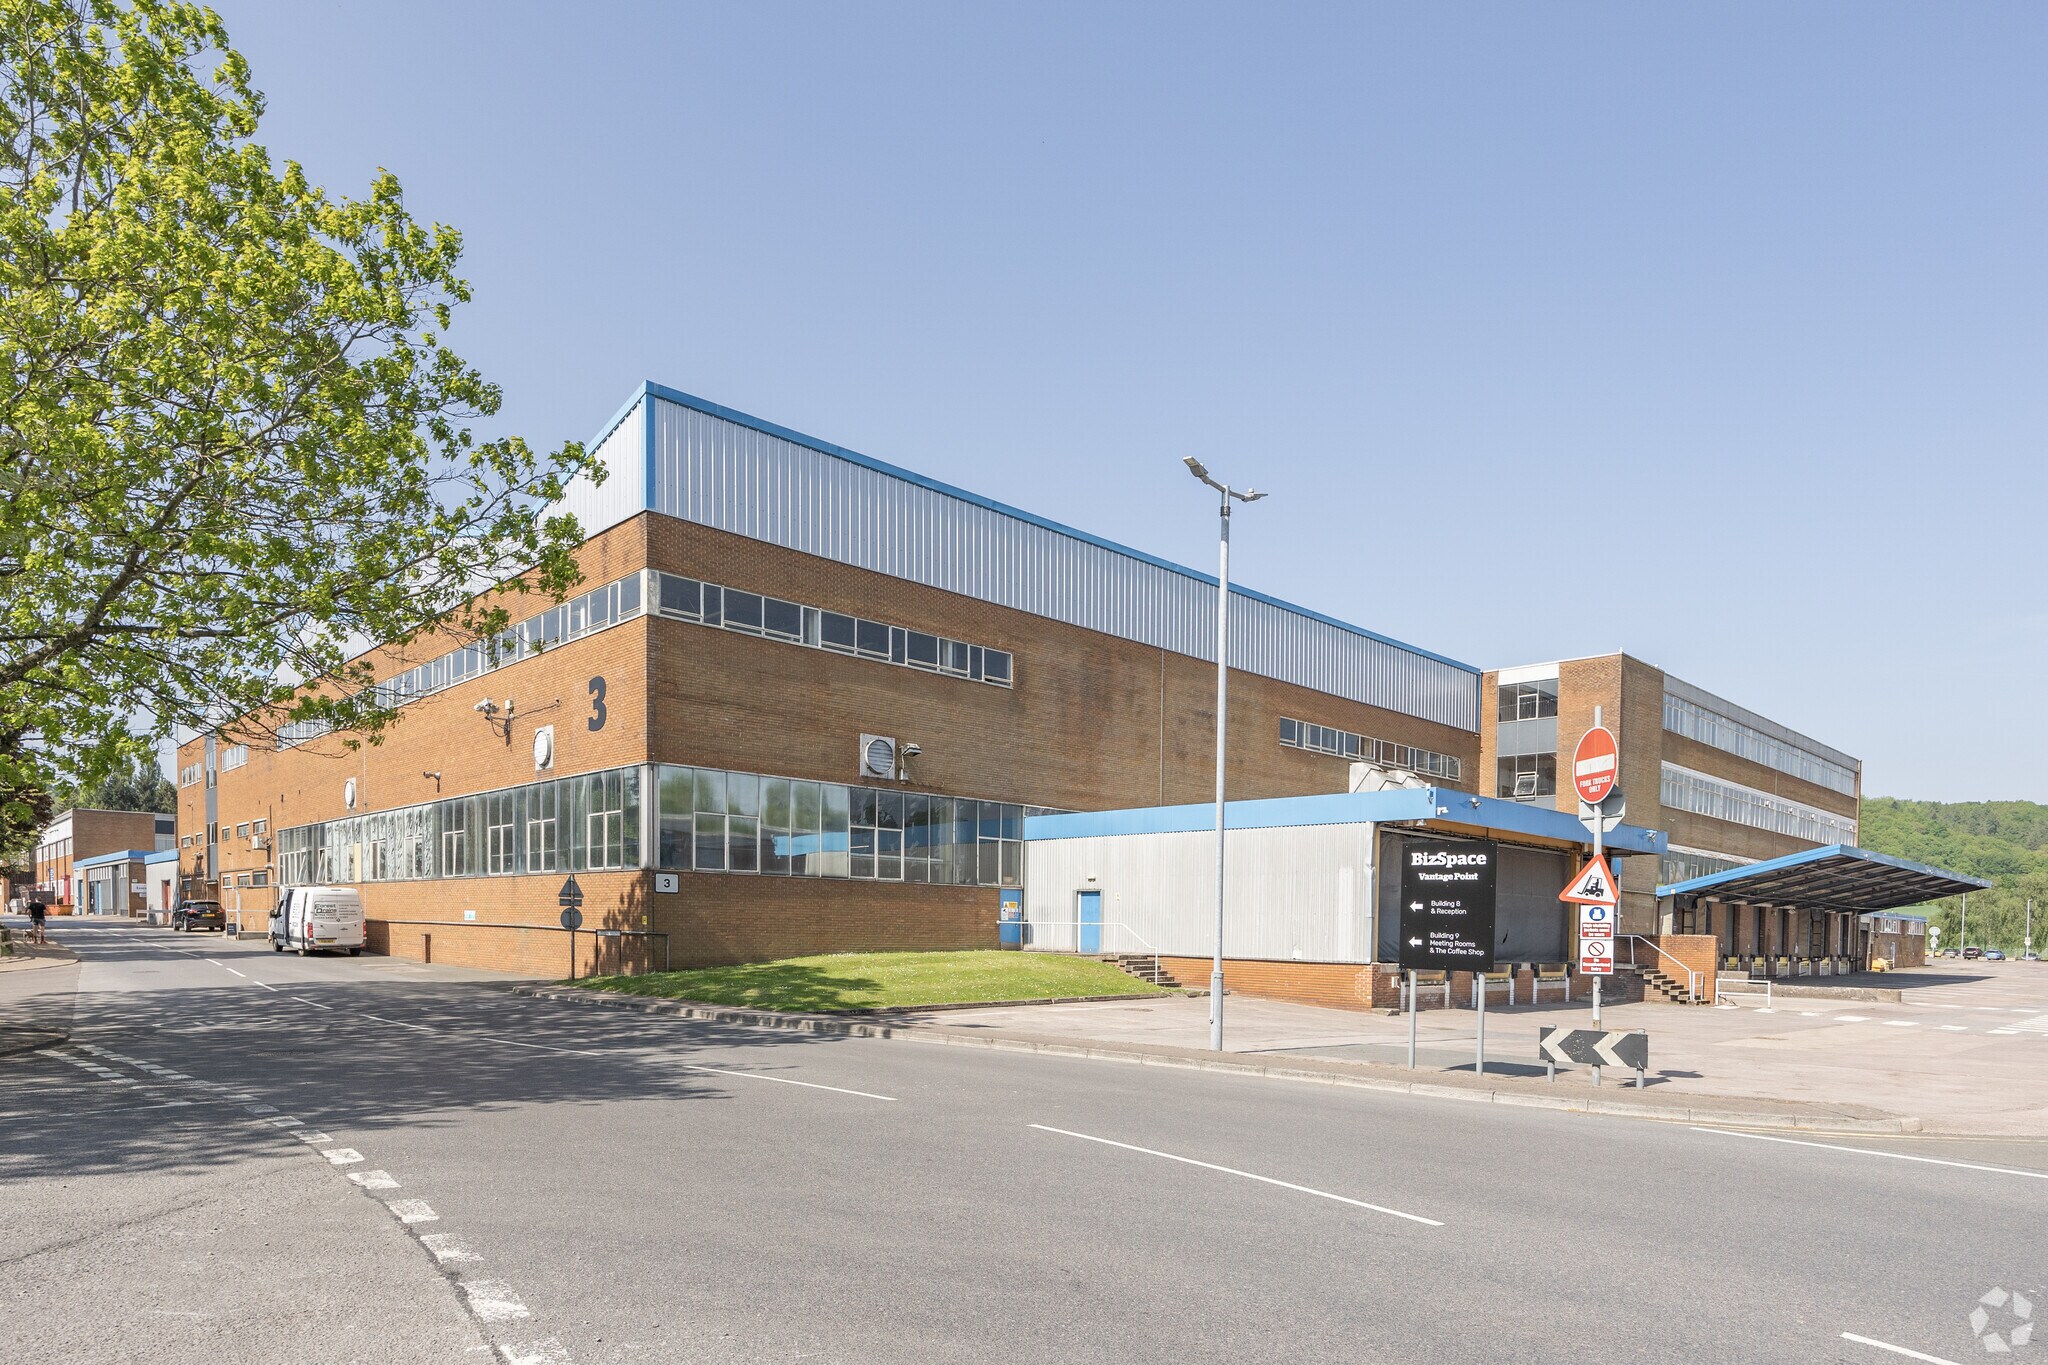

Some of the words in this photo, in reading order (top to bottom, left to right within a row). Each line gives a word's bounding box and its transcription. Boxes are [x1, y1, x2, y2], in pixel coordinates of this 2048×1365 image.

[588, 675, 607, 731] 3
[1592, 775, 1611, 785] TRUCKS
[1589, 785, 1601, 793] ONLY
[1411, 851, 1487, 868] BizSpace
[1418, 872, 1453, 882] Vantage
[1453, 872, 1479, 880] Point
[663, 878, 671, 888] 3
[1430, 900, 1455, 908] Building
[1430, 932, 1454, 940] Building
[1429, 939, 1454, 947] Meeting
[1454, 940, 1476, 948] Rooms
[1468, 948, 1485, 956] Shop
